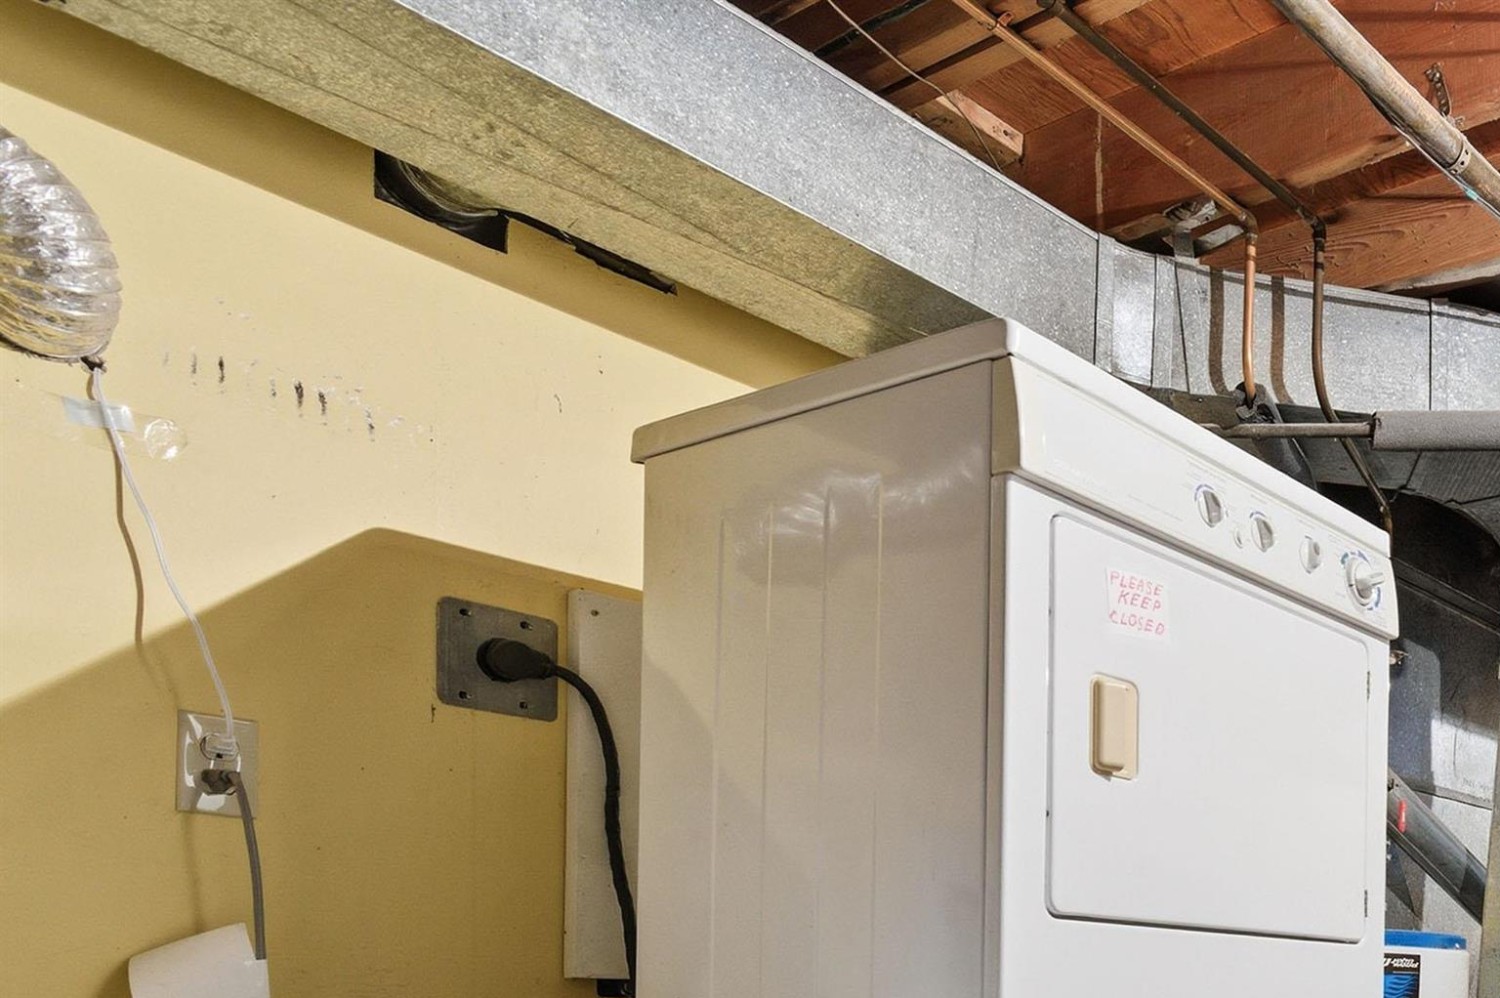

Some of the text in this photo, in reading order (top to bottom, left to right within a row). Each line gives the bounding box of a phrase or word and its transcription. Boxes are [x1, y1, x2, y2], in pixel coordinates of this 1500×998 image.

[1110, 571, 1164, 596] PLEASE
[1118, 589, 1161, 612] KEEP
[1109, 610, 1165, 635] CLOSED
